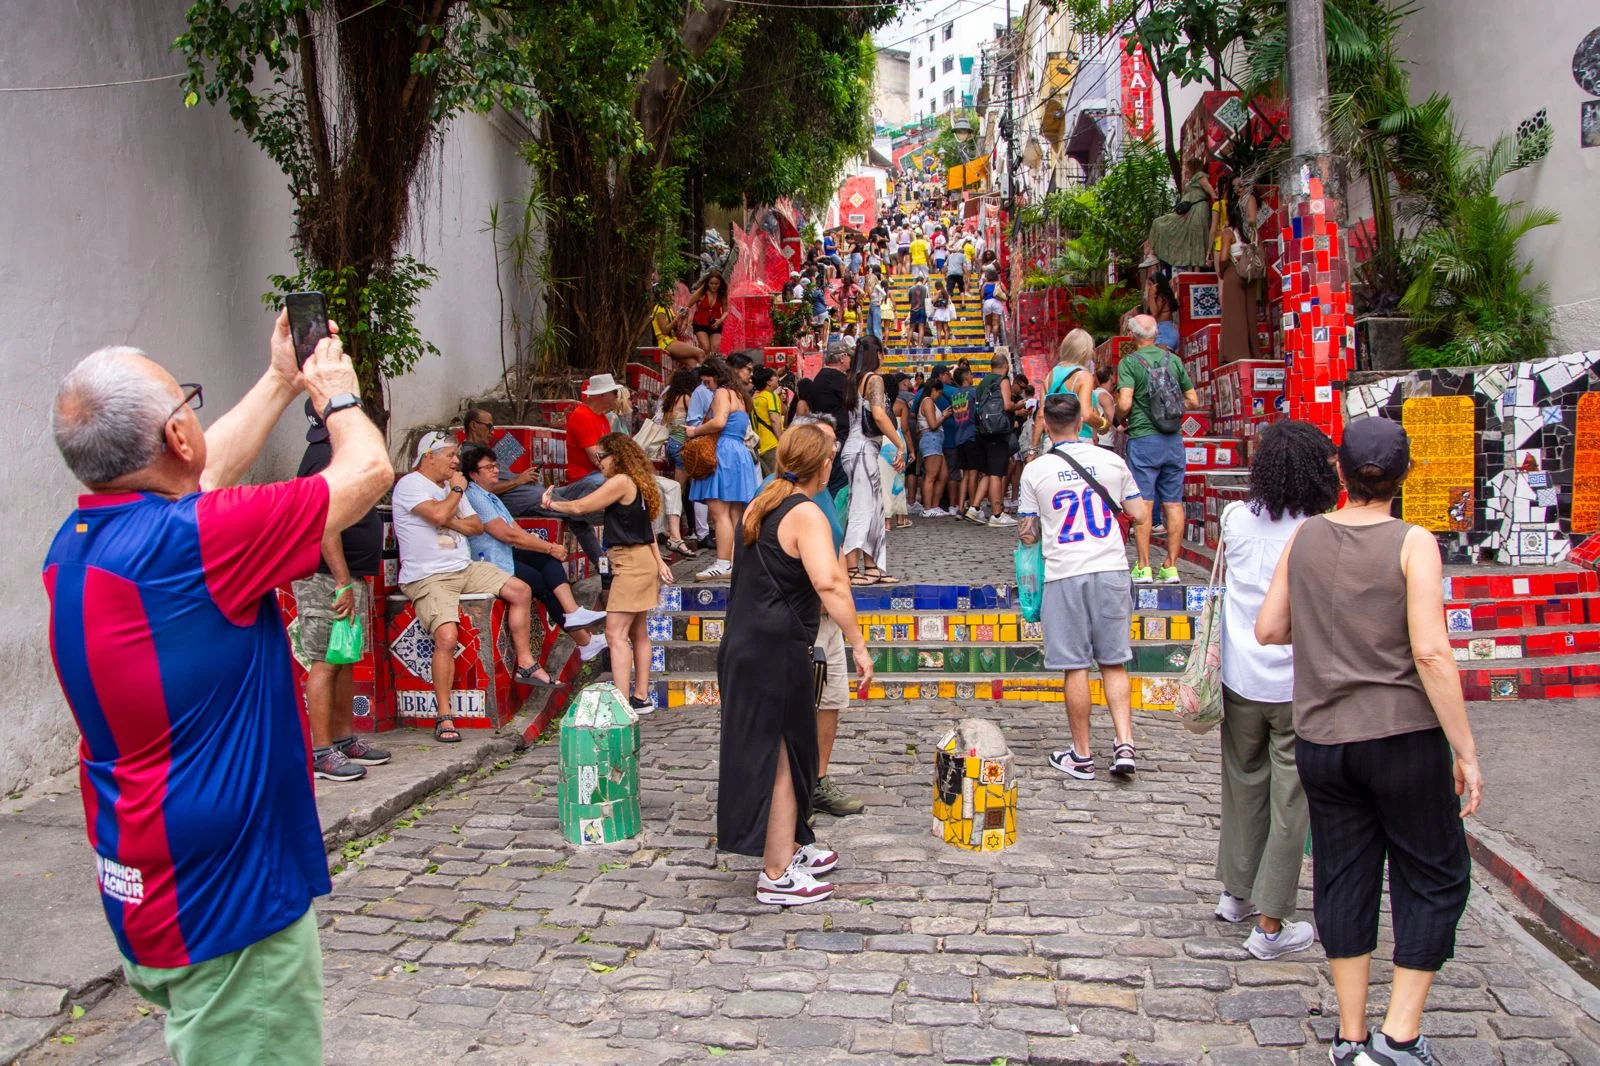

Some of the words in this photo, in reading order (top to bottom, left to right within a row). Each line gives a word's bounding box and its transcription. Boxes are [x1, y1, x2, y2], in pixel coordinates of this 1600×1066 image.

[1057, 466, 1096, 482] ASSI
[1052, 485, 1113, 545] 20
[403, 695, 479, 712] BRAIL
[103, 857, 143, 882] UNHCR
[103, 872, 144, 898] ACNUR
